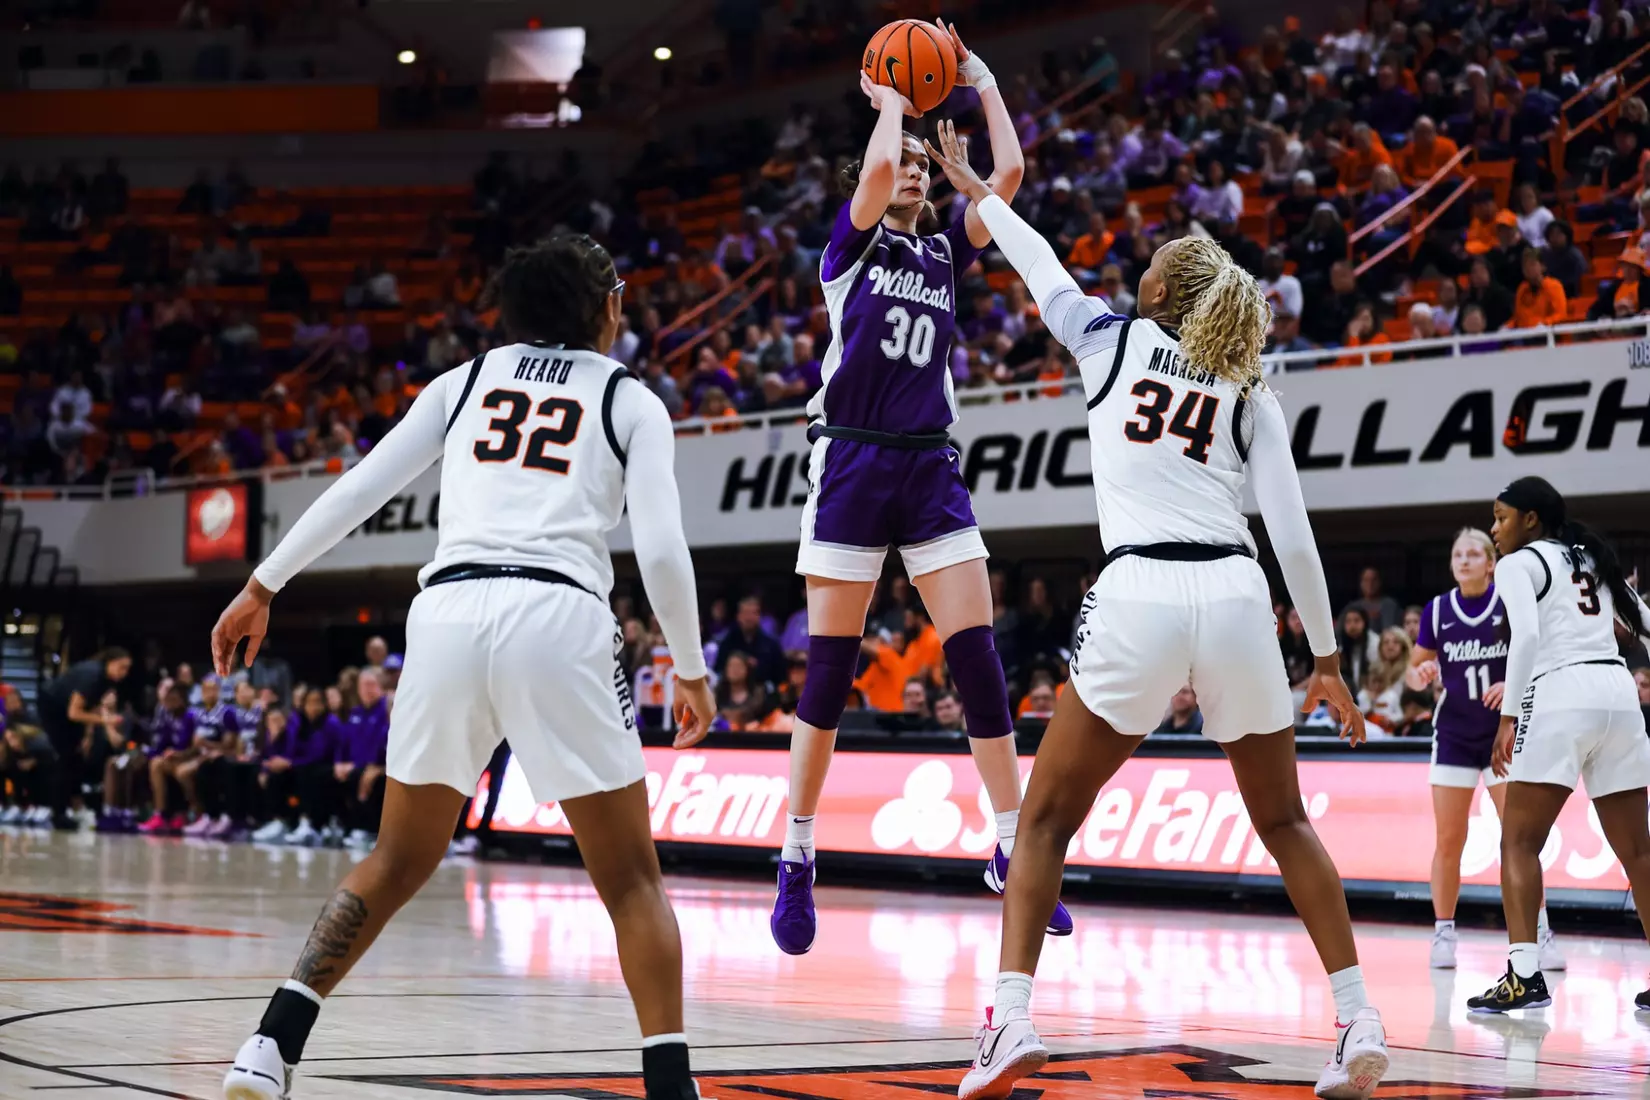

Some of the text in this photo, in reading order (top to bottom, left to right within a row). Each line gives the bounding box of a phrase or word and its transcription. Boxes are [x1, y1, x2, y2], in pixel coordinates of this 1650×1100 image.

[868, 265, 951, 313] Wildcats
[880, 305, 937, 368] 30
[513, 355, 574, 386] HEARD
[472, 388, 584, 477] 32
[1123, 377, 1221, 466] 34
[1570, 571, 1601, 617] 3
[1442, 638, 1509, 663] Wildcats
[1464, 664, 1492, 701] 11
[1513, 685, 1536, 754] COWGIRLS
